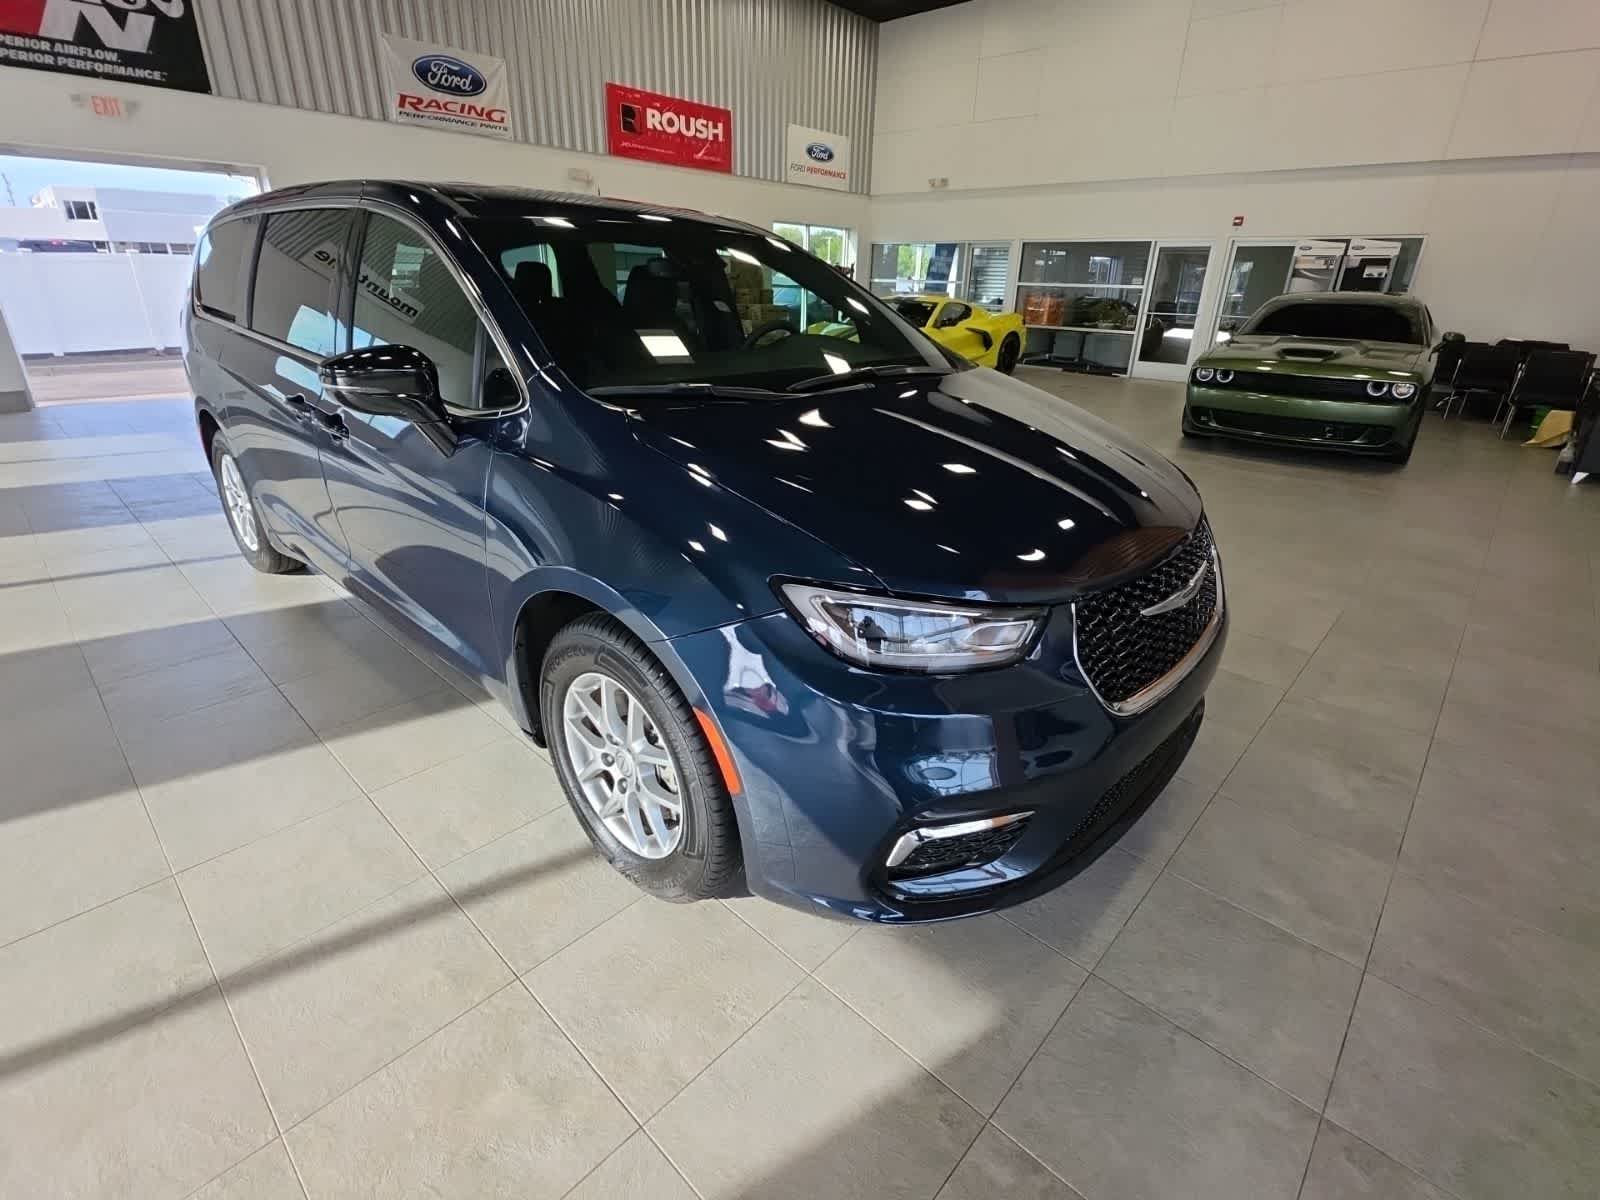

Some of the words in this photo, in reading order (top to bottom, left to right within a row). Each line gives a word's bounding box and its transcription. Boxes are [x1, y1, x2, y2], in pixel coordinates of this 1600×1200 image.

[54, 42, 122, 62] AIRFLOW.
[427, 60, 473, 92] Ford
[91, 95, 121, 117] EXIT
[398, 93, 507, 123] RACING
[399, 111, 478, 128] PERFORMANCE
[479, 123, 509, 132] PARTS
[645, 107, 724, 142] ROUSH
[806, 166, 847, 180] PERFORMANCE
